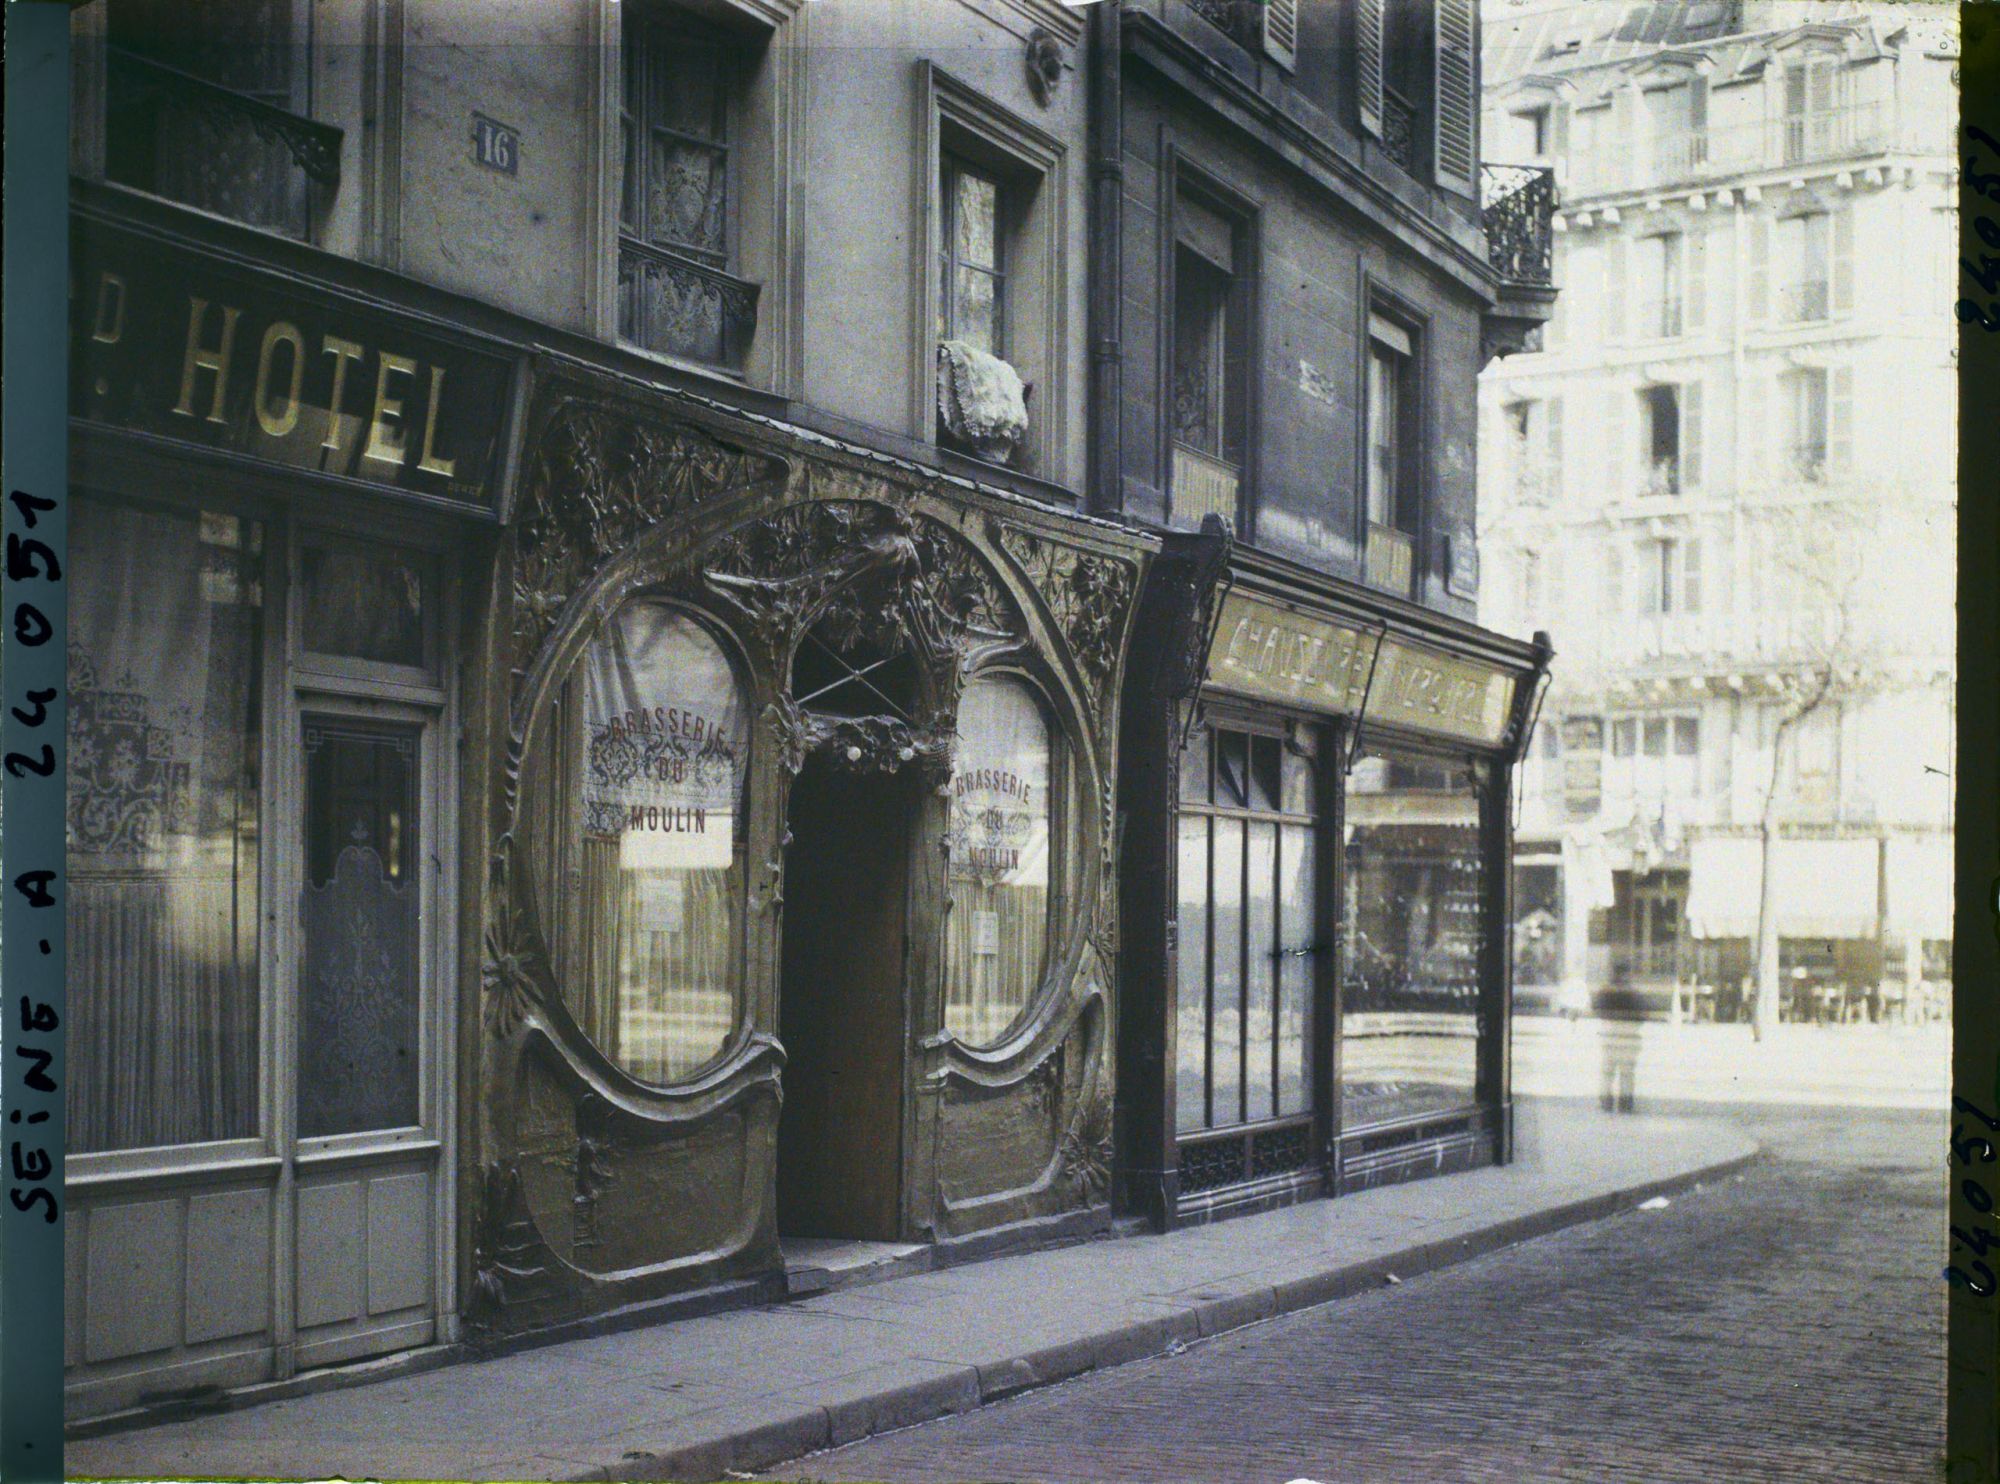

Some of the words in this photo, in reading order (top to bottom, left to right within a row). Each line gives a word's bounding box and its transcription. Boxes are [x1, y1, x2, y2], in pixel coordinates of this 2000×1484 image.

[484, 125, 509, 168] 16
[171, 295, 456, 478] HOTEL
[610, 707, 726, 751] BRASSERIE
[658, 757, 684, 783] DU
[956, 769, 1031, 805] BRASSERIE
[631, 805, 706, 834] MOULIN
[969, 847, 1019, 871] MOULIN
